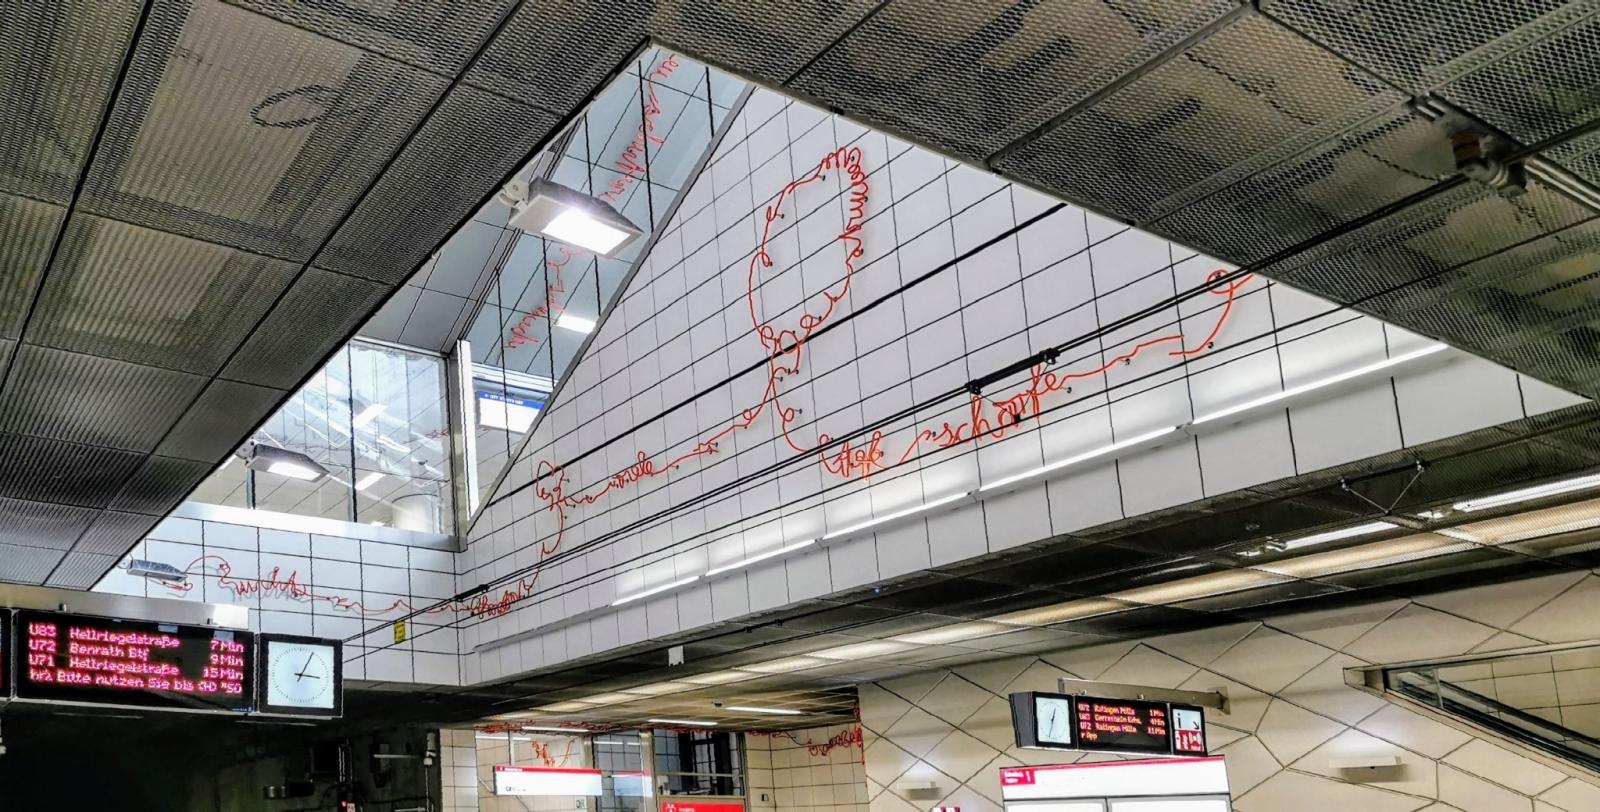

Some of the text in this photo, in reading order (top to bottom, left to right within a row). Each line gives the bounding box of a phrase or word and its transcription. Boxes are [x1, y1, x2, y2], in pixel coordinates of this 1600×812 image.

[29, 622, 56, 637] U83
[69, 626, 180, 648] Hellriegelstraße
[29, 638, 56, 652] U72
[69, 641, 125, 657] Benrath
[29, 652, 55, 667] U71
[69, 655, 180, 677] Hellriegelstraße
[57, 669, 91, 684] Bitte
[95, 674, 144, 689] nutzen
[148, 679, 170, 690] Sie
[174, 679, 194, 691] bis
